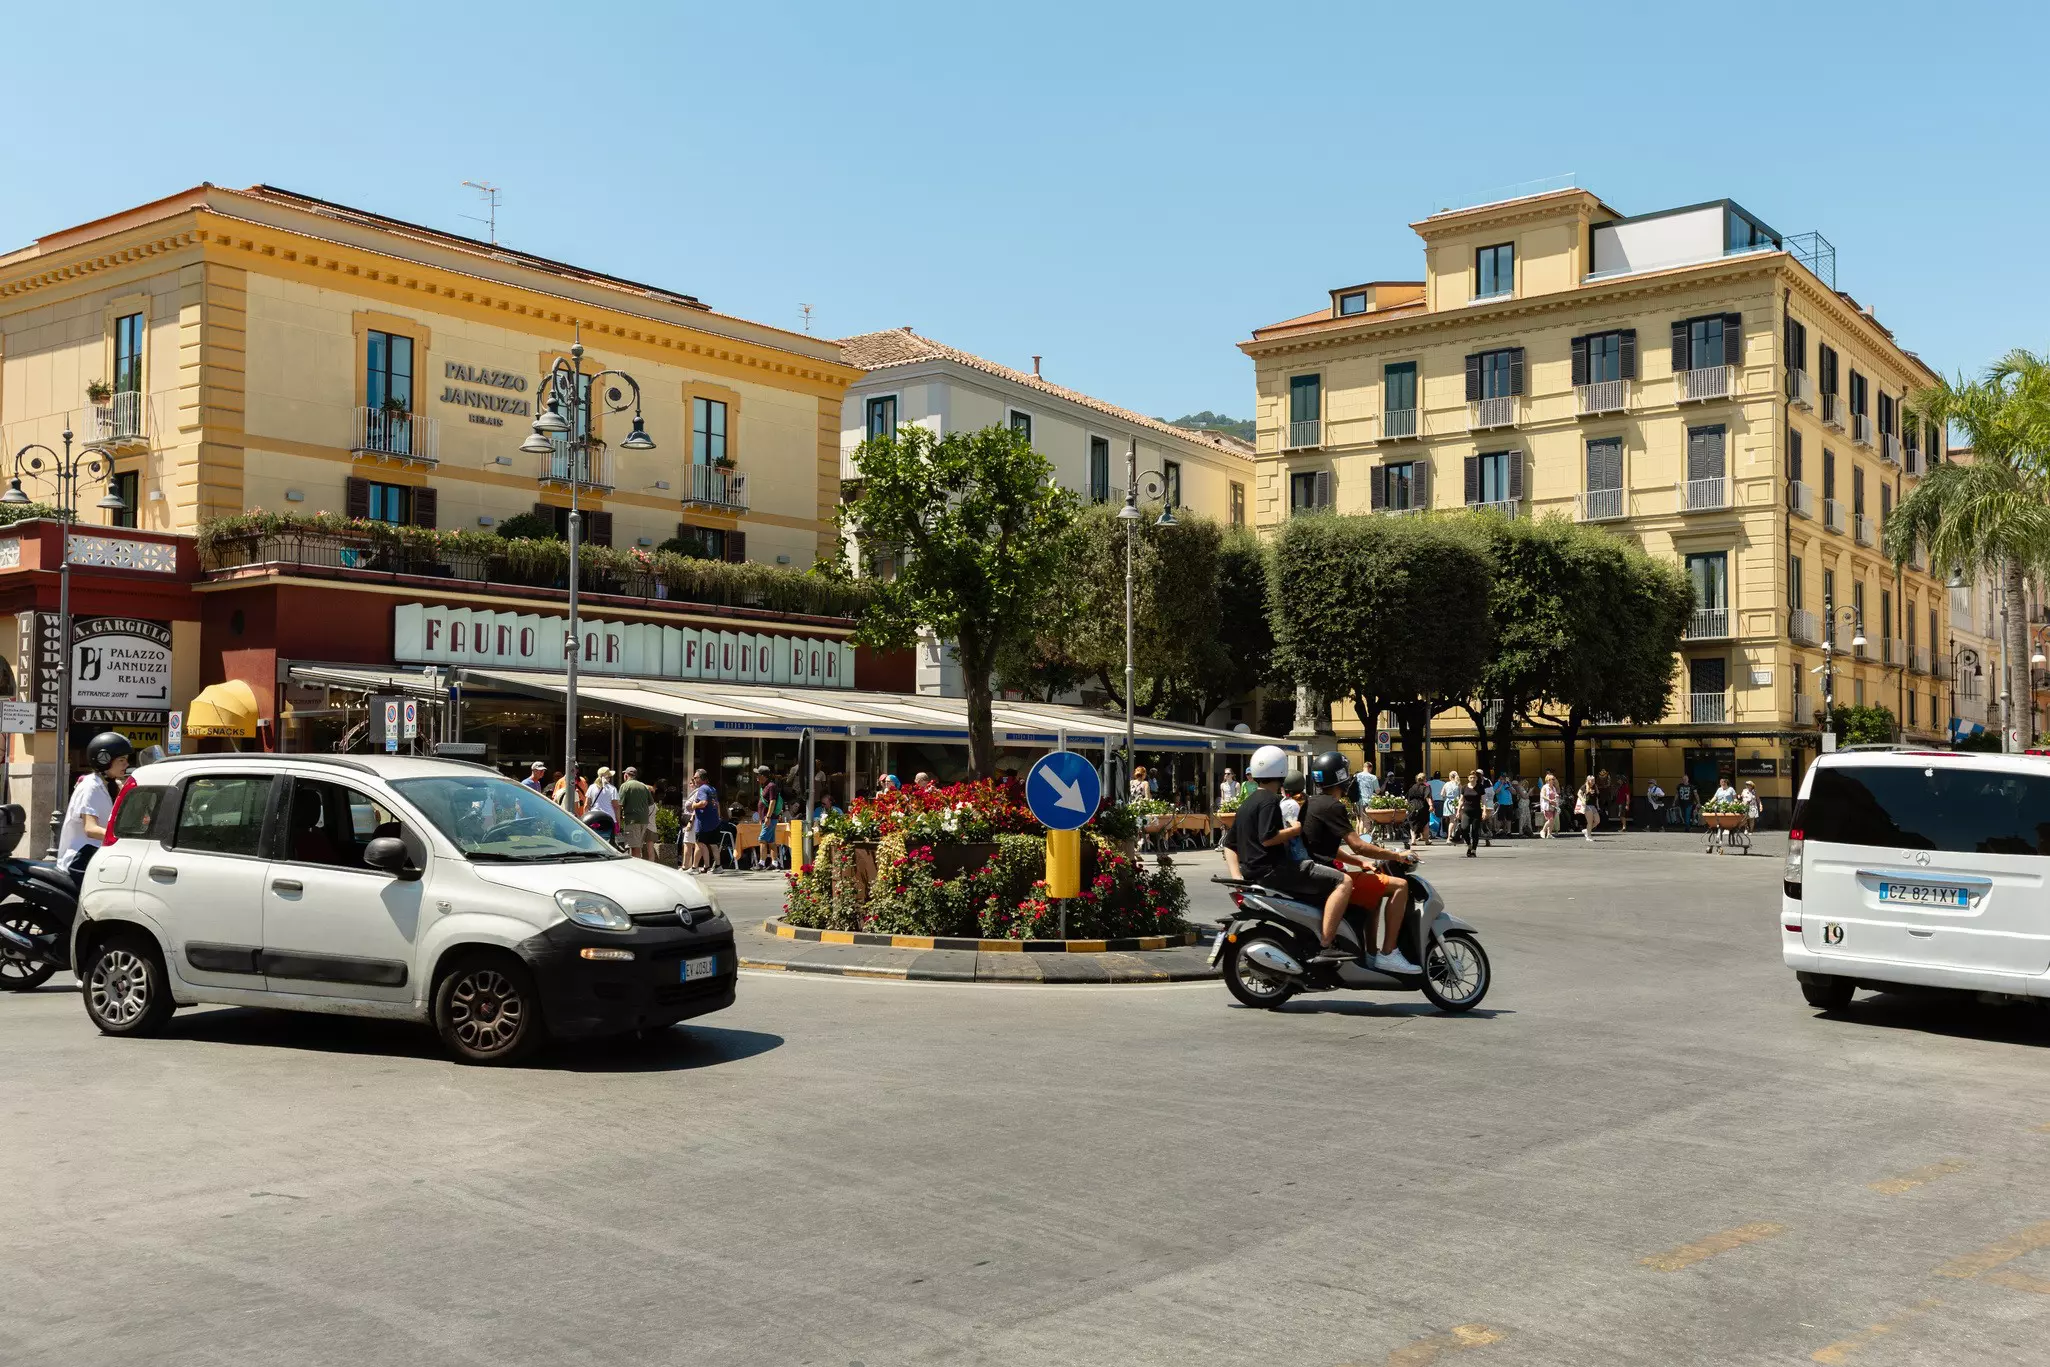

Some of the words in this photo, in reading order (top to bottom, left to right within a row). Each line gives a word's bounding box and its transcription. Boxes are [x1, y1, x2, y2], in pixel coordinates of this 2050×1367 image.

[444, 361, 528, 393] PALAZZO
[440, 386, 531, 417] JANNUZZI
[468, 413, 504, 427] RELAIS
[43, 614, 61, 663] WOOD
[75, 625, 90, 639] A.
[91, 619, 170, 643] GARGIULO
[426, 619, 535, 658] FAUNO
[20, 619, 30, 703] LINEN
[110, 648, 166, 661] PALAZZO
[686, 639, 770, 674] FAUNO
[793, 648, 837, 678] BAR
[106, 661, 167, 673] JANNUZZI
[118, 675, 156, 685] RELAIS
[40, 668, 60, 729] WORKS
[77, 690, 110, 698] ENTRANCE
[82, 709, 161, 723] JANNUZZI
[128, 731, 158, 741] ATM
[207, 728, 245, 736] SNACKS
[1889, 885, 1907, 899] CZ
[1912, 887, 1957, 903] 821XY
[1823, 925, 1844, 945] 19
